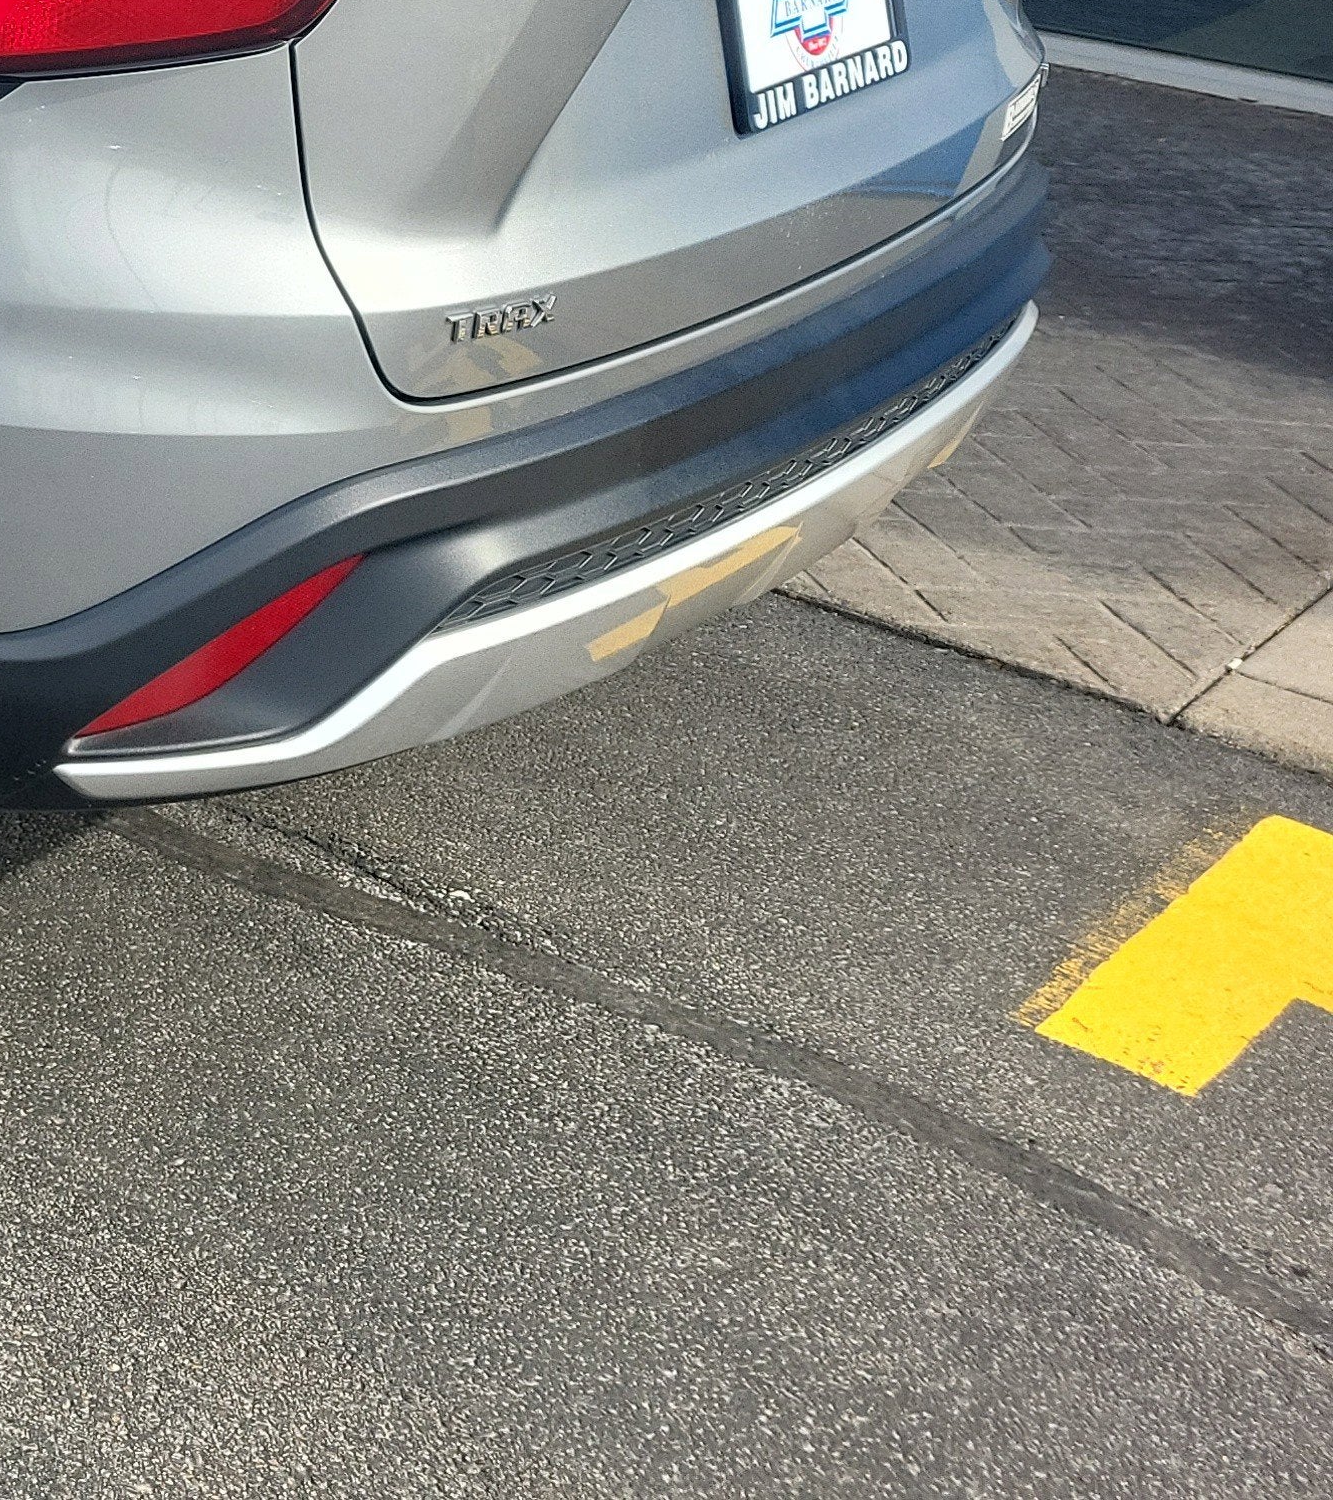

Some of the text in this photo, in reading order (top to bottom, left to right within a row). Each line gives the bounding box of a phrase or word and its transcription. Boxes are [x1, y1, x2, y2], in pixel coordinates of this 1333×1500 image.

[753, 39, 908, 129] JIM BARNARD
[445, 292, 558, 344] TRAX
